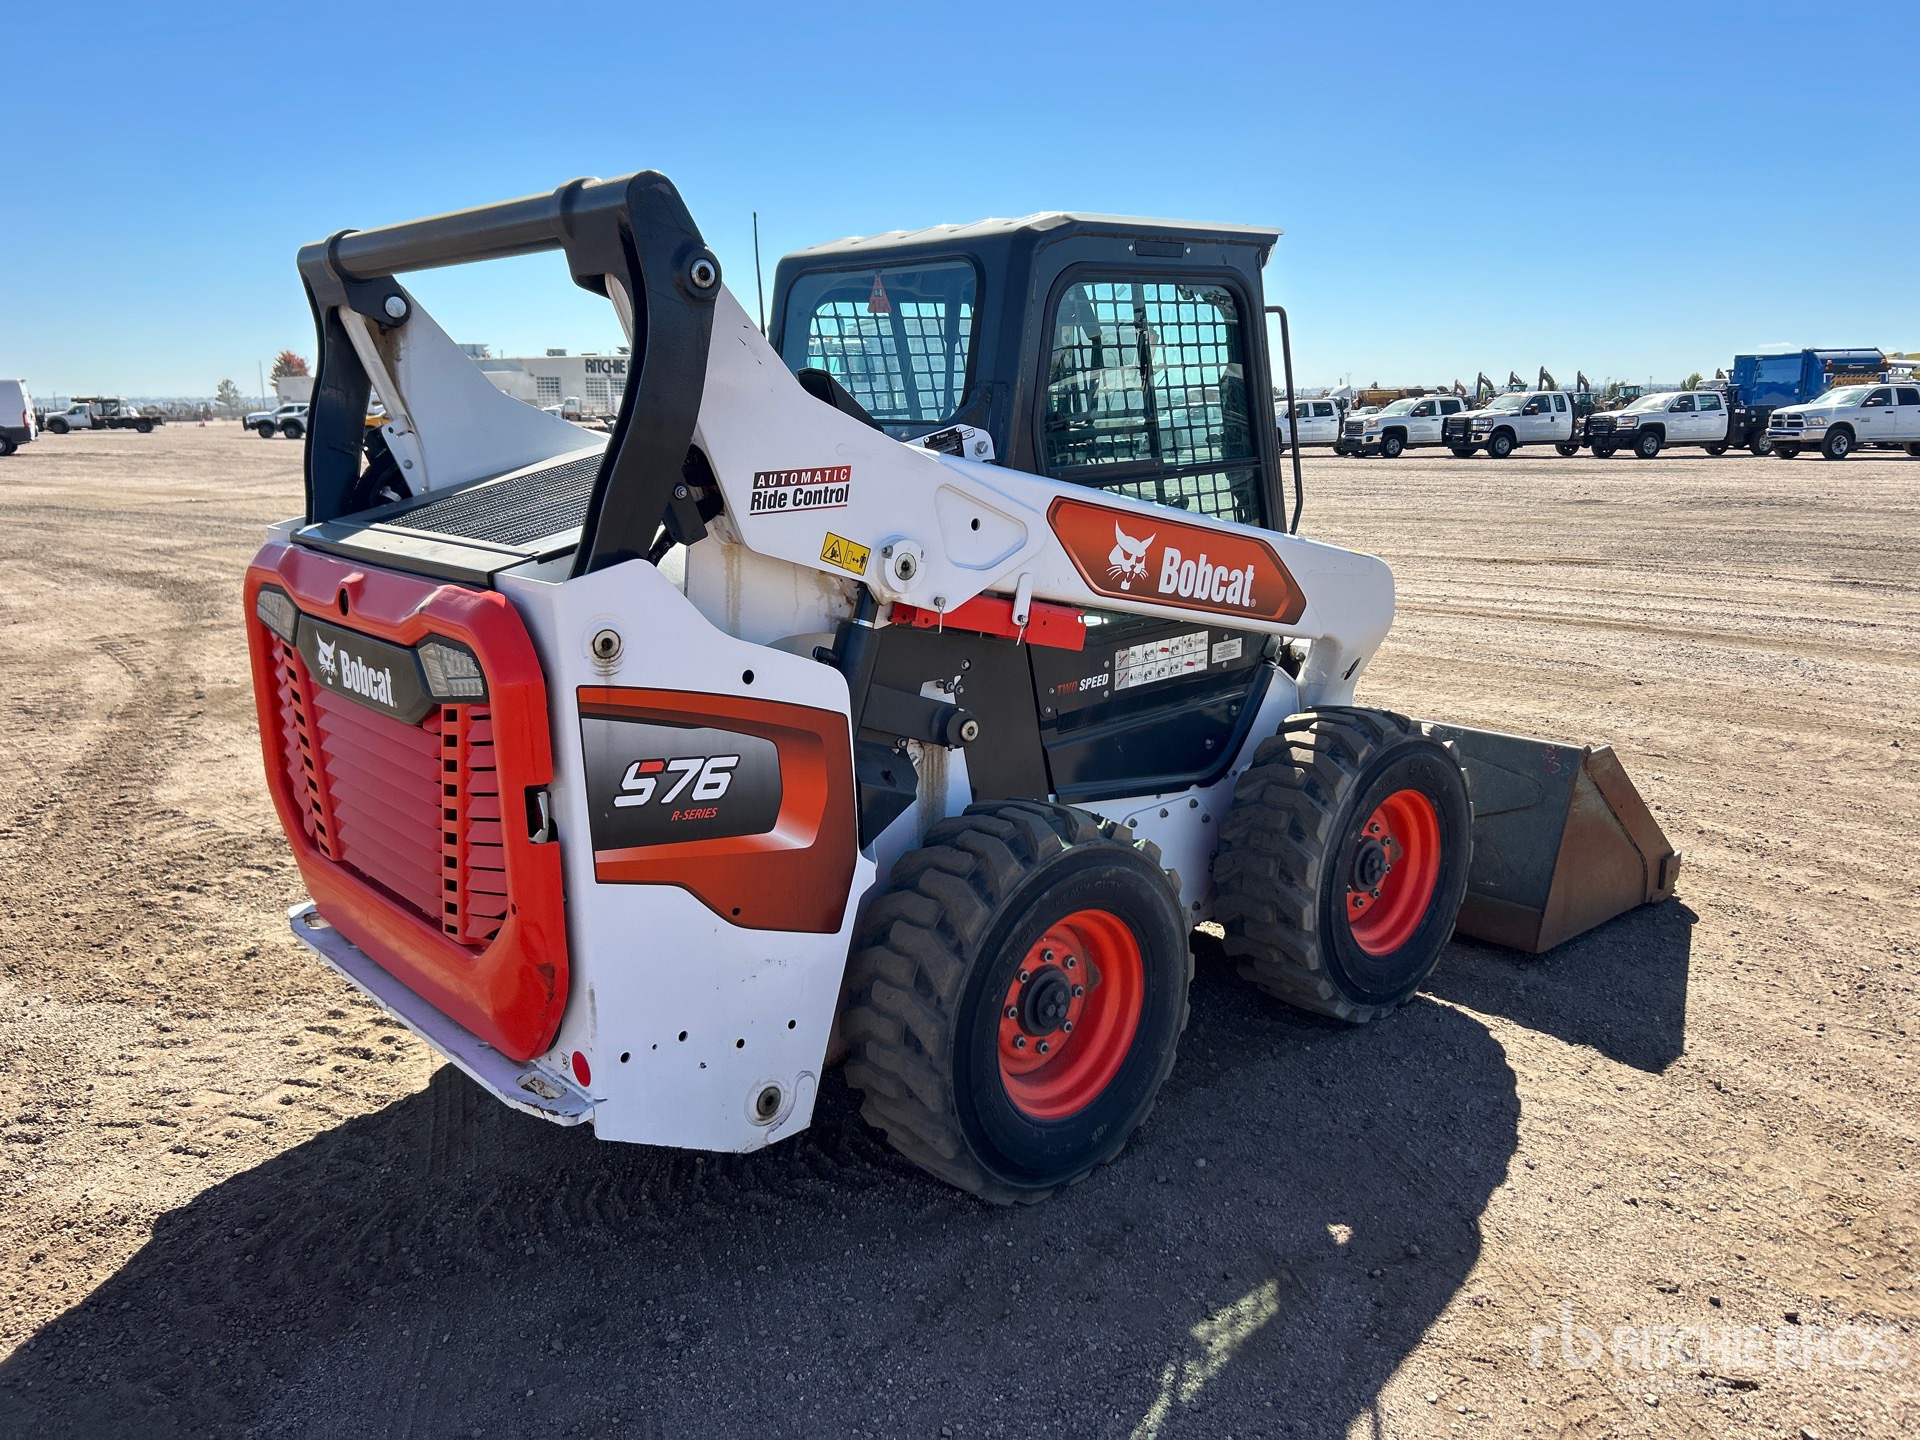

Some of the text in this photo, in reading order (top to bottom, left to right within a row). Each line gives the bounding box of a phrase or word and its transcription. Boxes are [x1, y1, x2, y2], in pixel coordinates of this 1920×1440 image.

[585, 359, 626, 373] RITCHIE
[757, 468, 848, 487] AUTOMATIC
[750, 483, 850, 511] Ride Control
[1158, 546, 1255, 607] Bobcat
[340, 649, 394, 707] Bobcat
[1057, 673, 1109, 696] TWO SPEED
[613, 755, 740, 808] S76
[671, 807, 718, 821] R-SERIES
